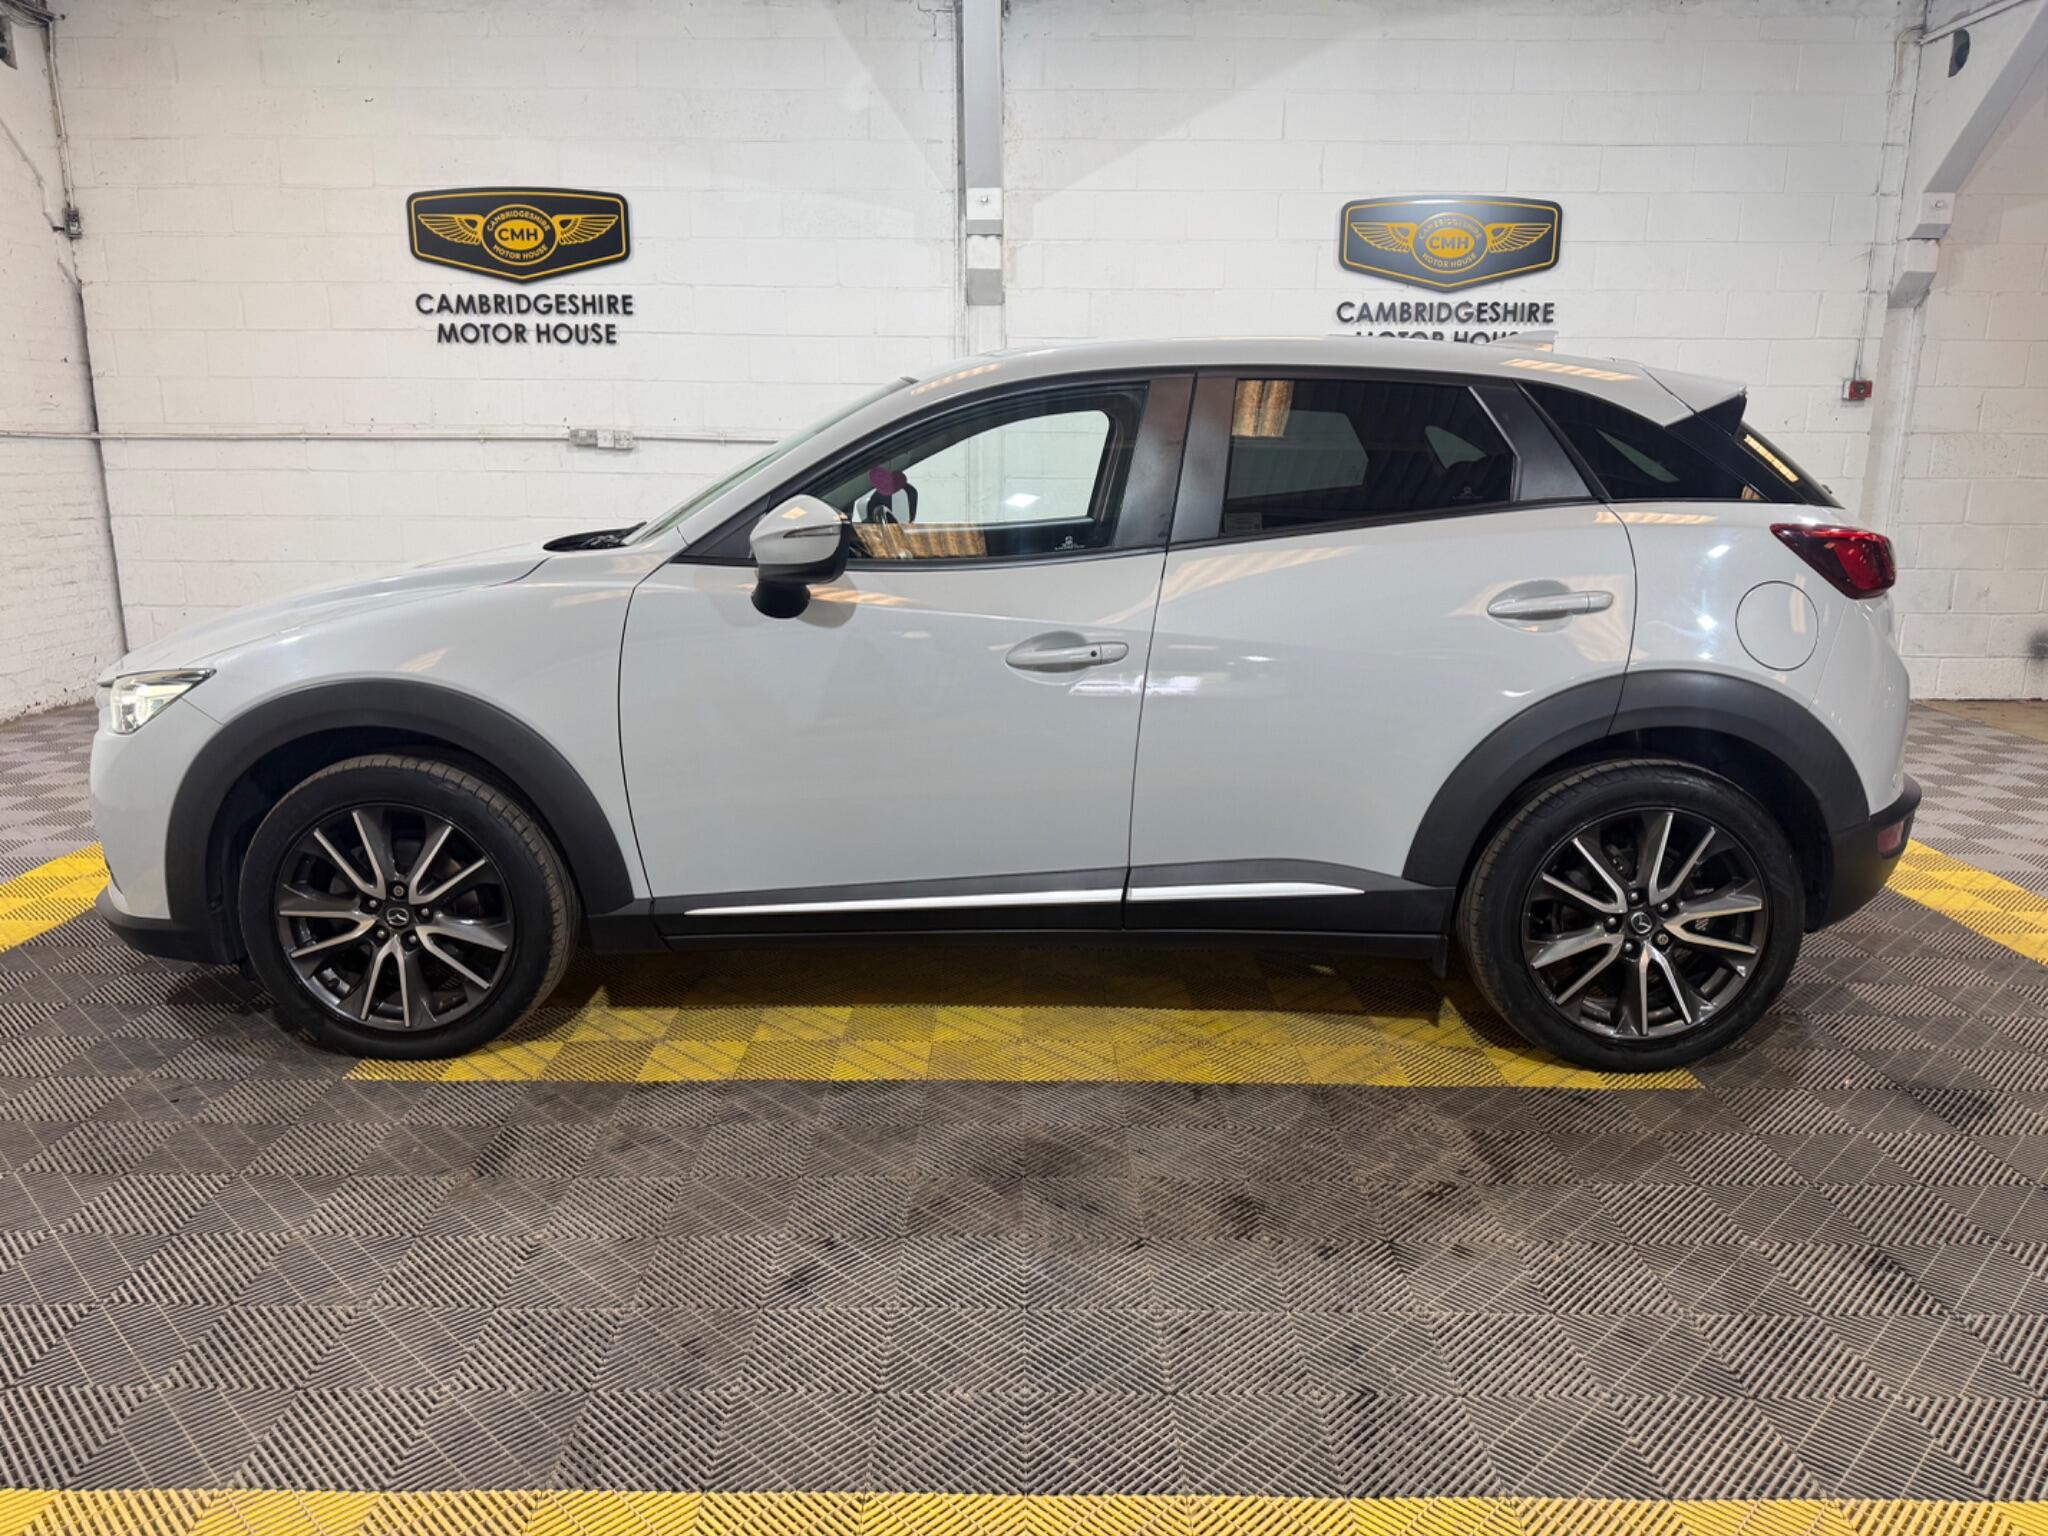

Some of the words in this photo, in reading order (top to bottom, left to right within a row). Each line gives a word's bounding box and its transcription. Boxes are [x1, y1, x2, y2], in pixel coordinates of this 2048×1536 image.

[487, 210, 551, 232] CAMBRIDGESHIRE
[498, 228, 538, 241] CMH
[1429, 236, 1469, 249] CMH
[493, 243, 521, 259] MOTOR
[523, 243, 549, 260] HOUSE
[1423, 252, 1450, 268] MOTOR
[1451, 252, 1476, 268] HOUSE
[415, 292, 634, 316] CAMBRIDGESHIRE
[1336, 300, 1556, 324] CAMBRIDGESHIRE
[437, 322, 527, 344] MOTOR
[536, 322, 617, 345] HOUSE
